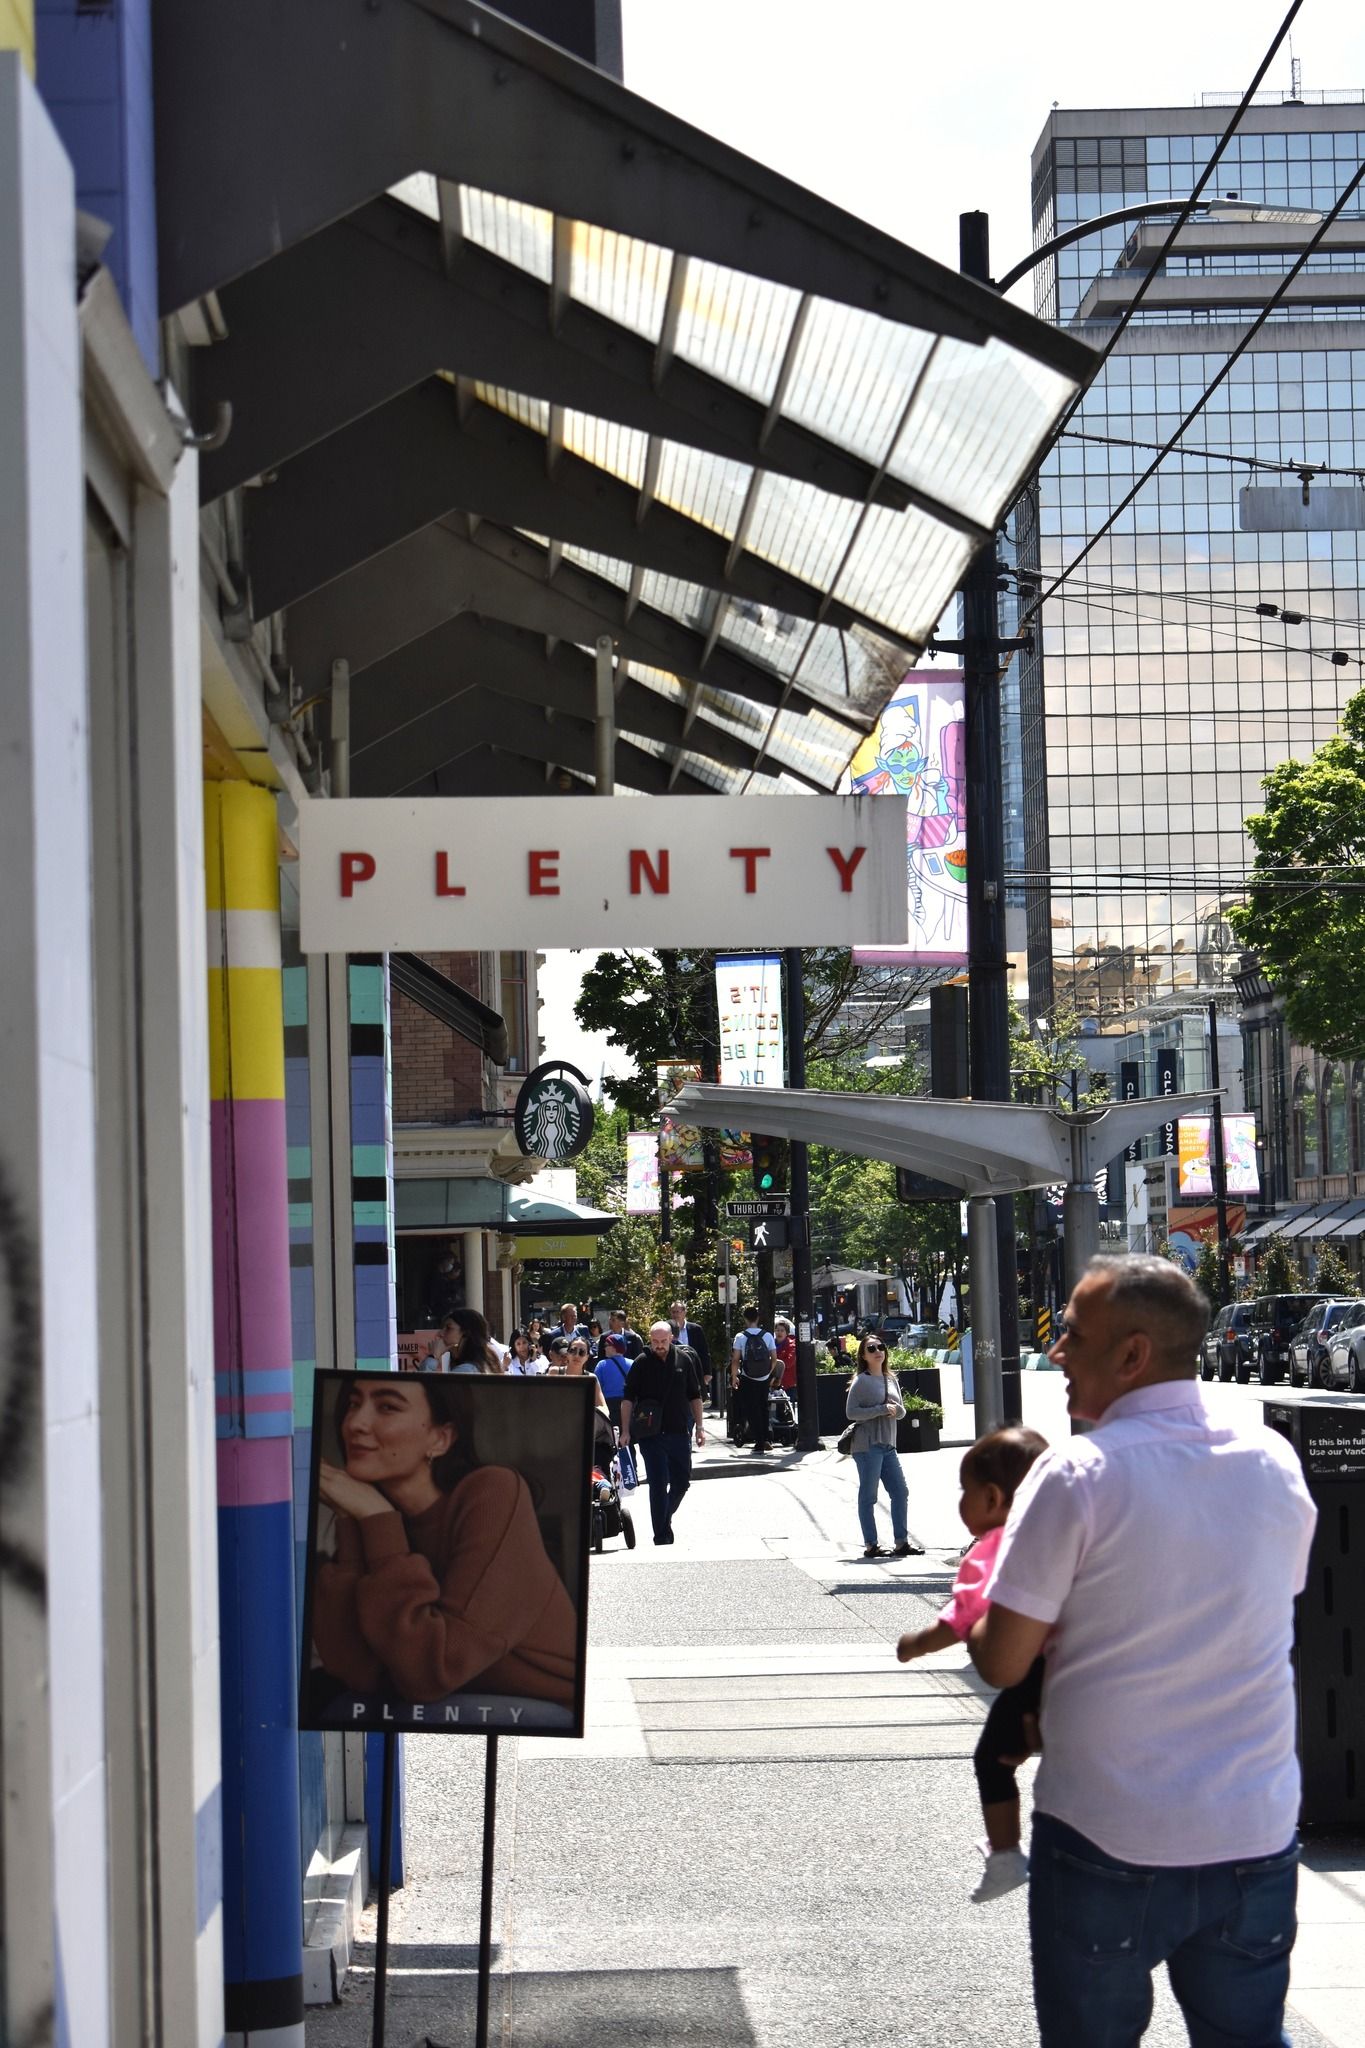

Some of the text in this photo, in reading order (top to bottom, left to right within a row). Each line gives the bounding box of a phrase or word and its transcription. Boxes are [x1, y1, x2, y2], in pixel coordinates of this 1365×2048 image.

[339, 847, 867, 897] PLENTY
[733, 1204, 768, 1214] THURLOW
[1309, 1438, 1317, 1446] Is
[1318, 1438, 1335, 1446] this
[1336, 1438, 1351, 1446] bin
[1309, 1448, 1326, 1456] Use
[1344, 1447, 1365, 1456] VanC
[352, 1703, 523, 1724] PLENTY
